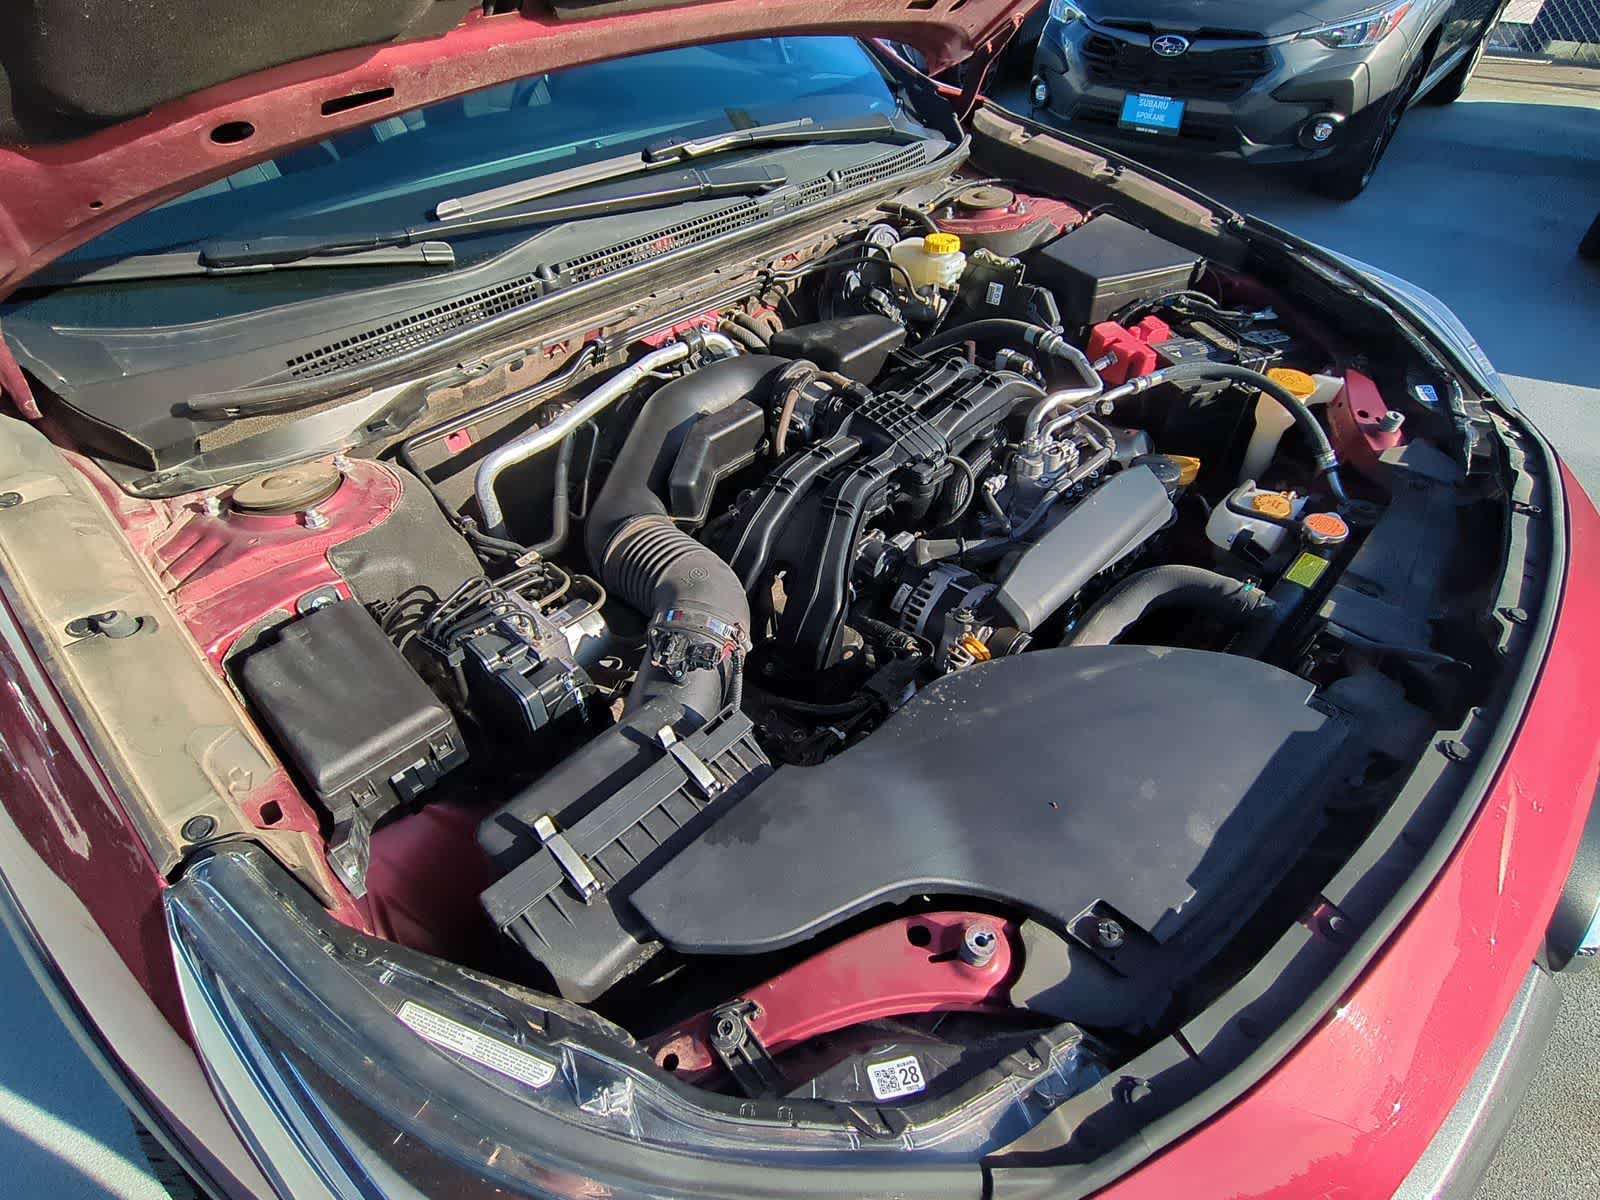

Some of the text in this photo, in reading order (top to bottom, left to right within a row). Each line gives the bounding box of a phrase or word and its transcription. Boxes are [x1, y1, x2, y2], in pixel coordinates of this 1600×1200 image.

[1138, 99, 1169, 110] SUBARU
[1136, 112, 1166, 122] SPOKANE
[899, 1066, 920, 1085] 28
